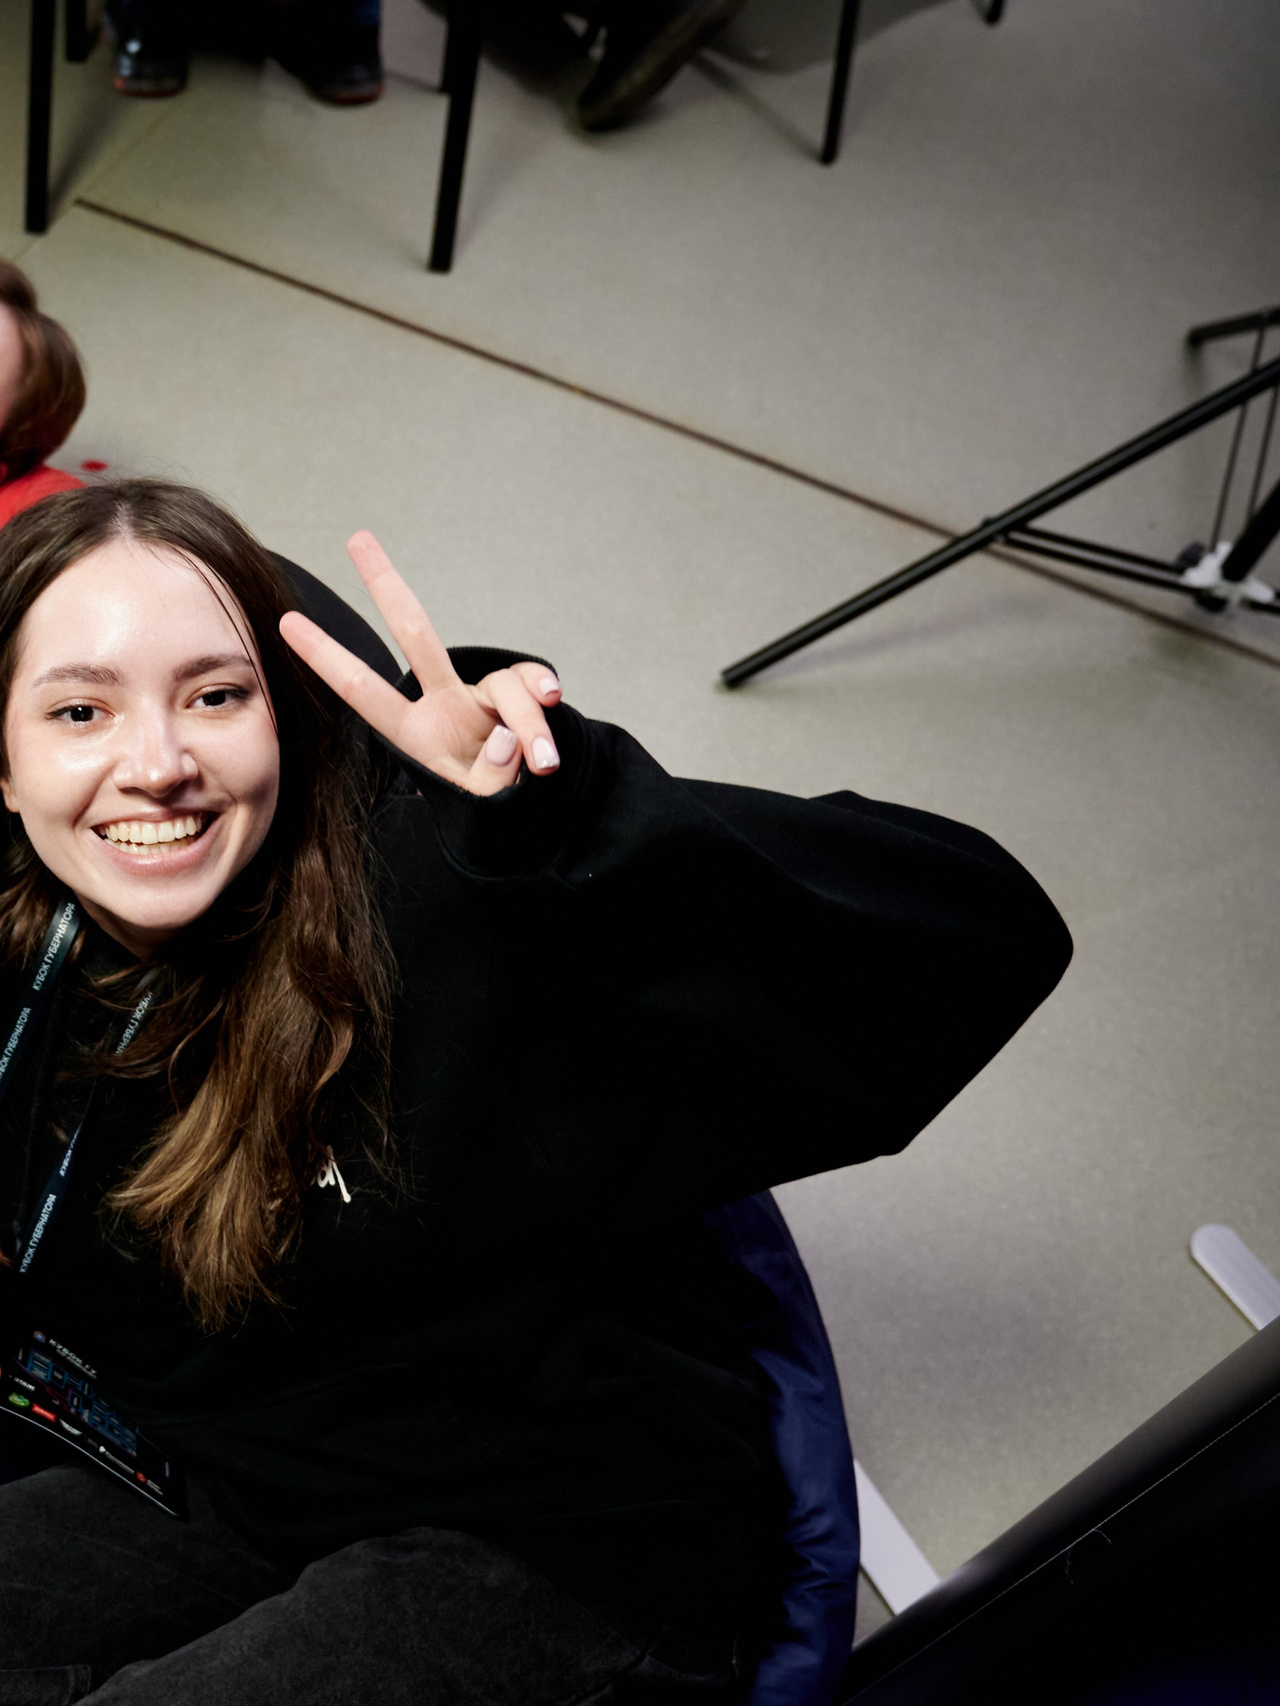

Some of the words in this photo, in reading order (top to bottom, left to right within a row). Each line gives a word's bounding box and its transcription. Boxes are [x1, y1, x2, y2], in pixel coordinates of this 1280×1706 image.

[32, 962, 52, 992] КУБОК
[43, 902, 76, 963] ГУБЕРНАТОРА
[4, 1006, 32, 1057] ГУБЕРНАТОРА
[19, 1246, 37, 1274] КУБОК
[29, 1193, 57, 1247] ГУБЕРНАТОРА
